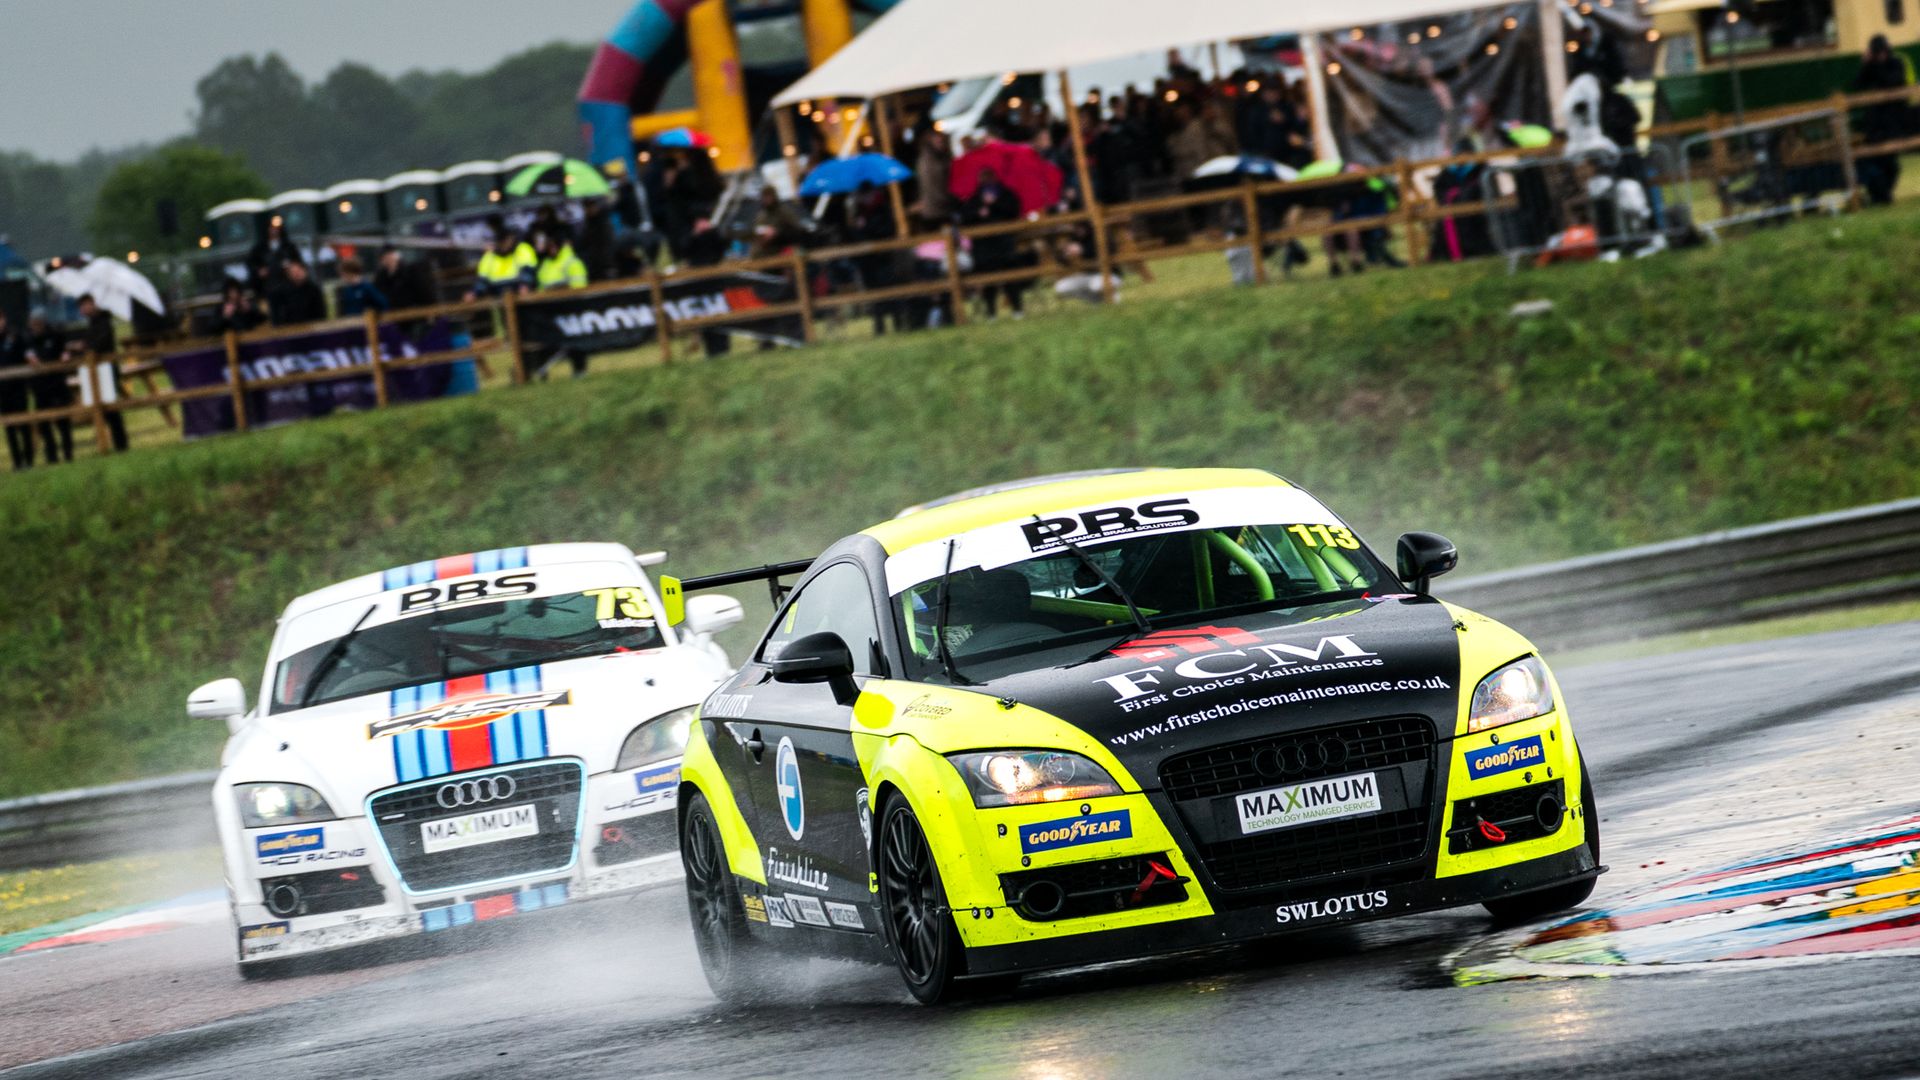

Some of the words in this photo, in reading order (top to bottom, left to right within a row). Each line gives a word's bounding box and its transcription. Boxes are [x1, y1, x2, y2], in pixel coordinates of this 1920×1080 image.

[1020, 498, 1200, 552] PBS
[1103, 526, 1134, 537] BRAKE
[1135, 520, 1188, 532] SOLUTIONS
[1288, 523, 1360, 550] 113
[400, 572, 537, 612] PBS
[582, 588, 654, 620] 73
[1092, 634, 1378, 703] FCM
[1119, 693, 1168, 713] First
[1172, 676, 1245, 698] Choice
[1247, 658, 1384, 682] Maintenance
[1110, 675, 1451, 746] www.firstchoicemaintenance.co.uk
[1474, 744, 1540, 771] GOODYEAR
[1242, 776, 1374, 819] MAXIMUM
[427, 808, 532, 842] MAXIMUM
[1247, 813, 1301, 830] TECHNOLOGY
[1302, 806, 1343, 821] MANAGED
[1343, 800, 1376, 813] SERVICE
[1028, 819, 1121, 846] GOODYEAR
[305, 847, 366, 862] RACING
[1275, 889, 1389, 924] SWLOTUS
